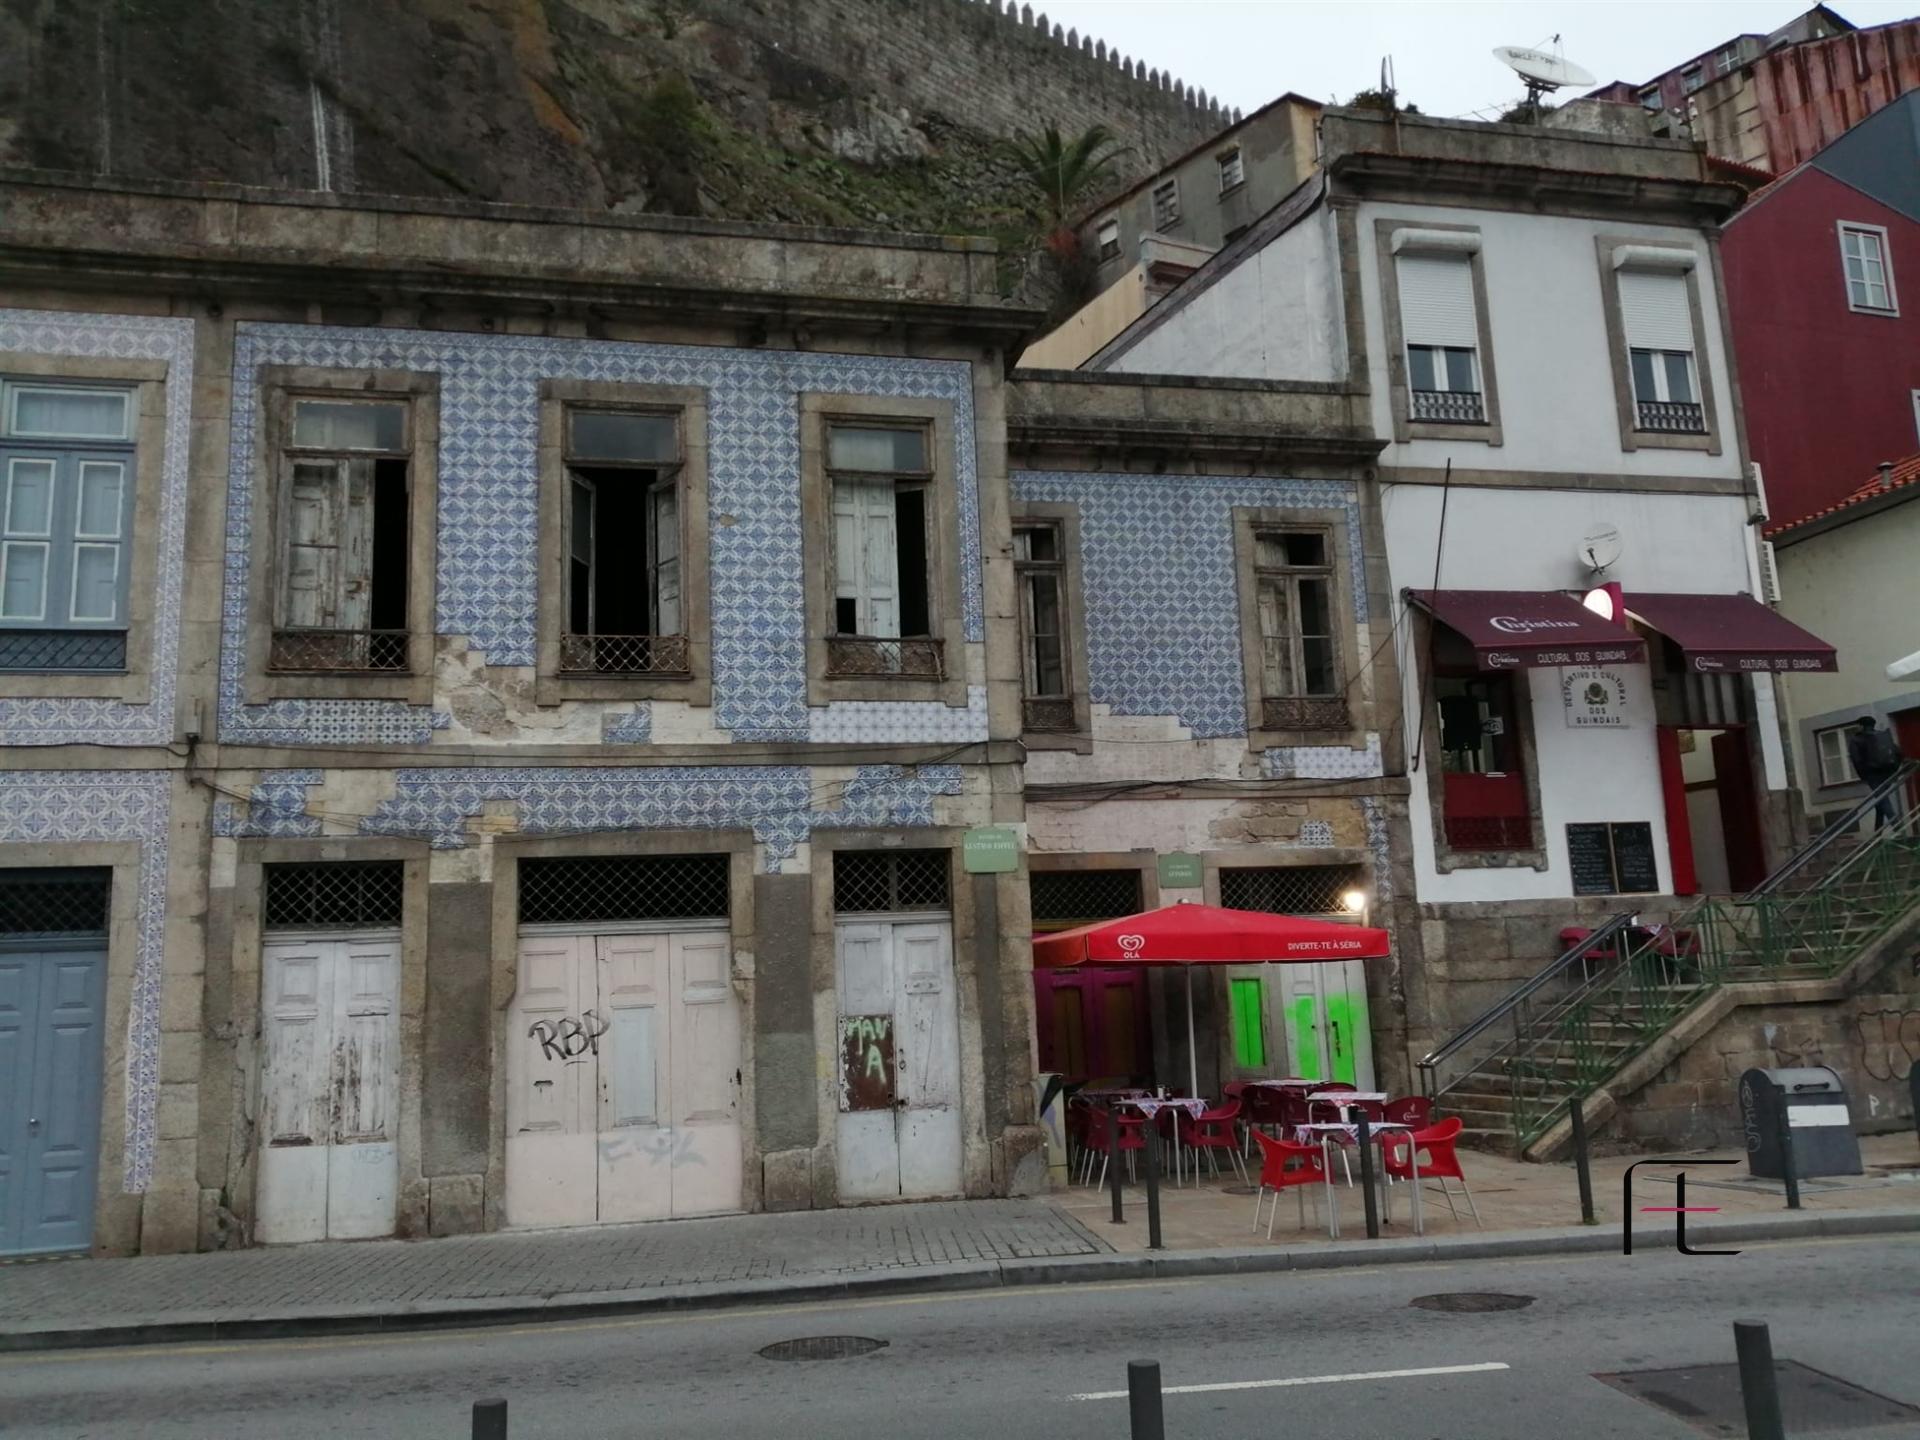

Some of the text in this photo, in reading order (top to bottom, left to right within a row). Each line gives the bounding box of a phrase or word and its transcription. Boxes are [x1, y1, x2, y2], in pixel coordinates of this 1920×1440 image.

[1489, 616, 1580, 633] Christina
[1537, 650, 1627, 664] CULTURAL DOS GUINDAIS
[1739, 659, 1770, 669] CULTURAL
[1775, 659, 1788, 668] DOS
[1592, 671, 1598, 679] E
[1600, 671, 1627, 706] CULTURAL
[1576, 716, 1621, 724] GUINDAIS
[1340, 939, 1362, 949] SÉRIA
